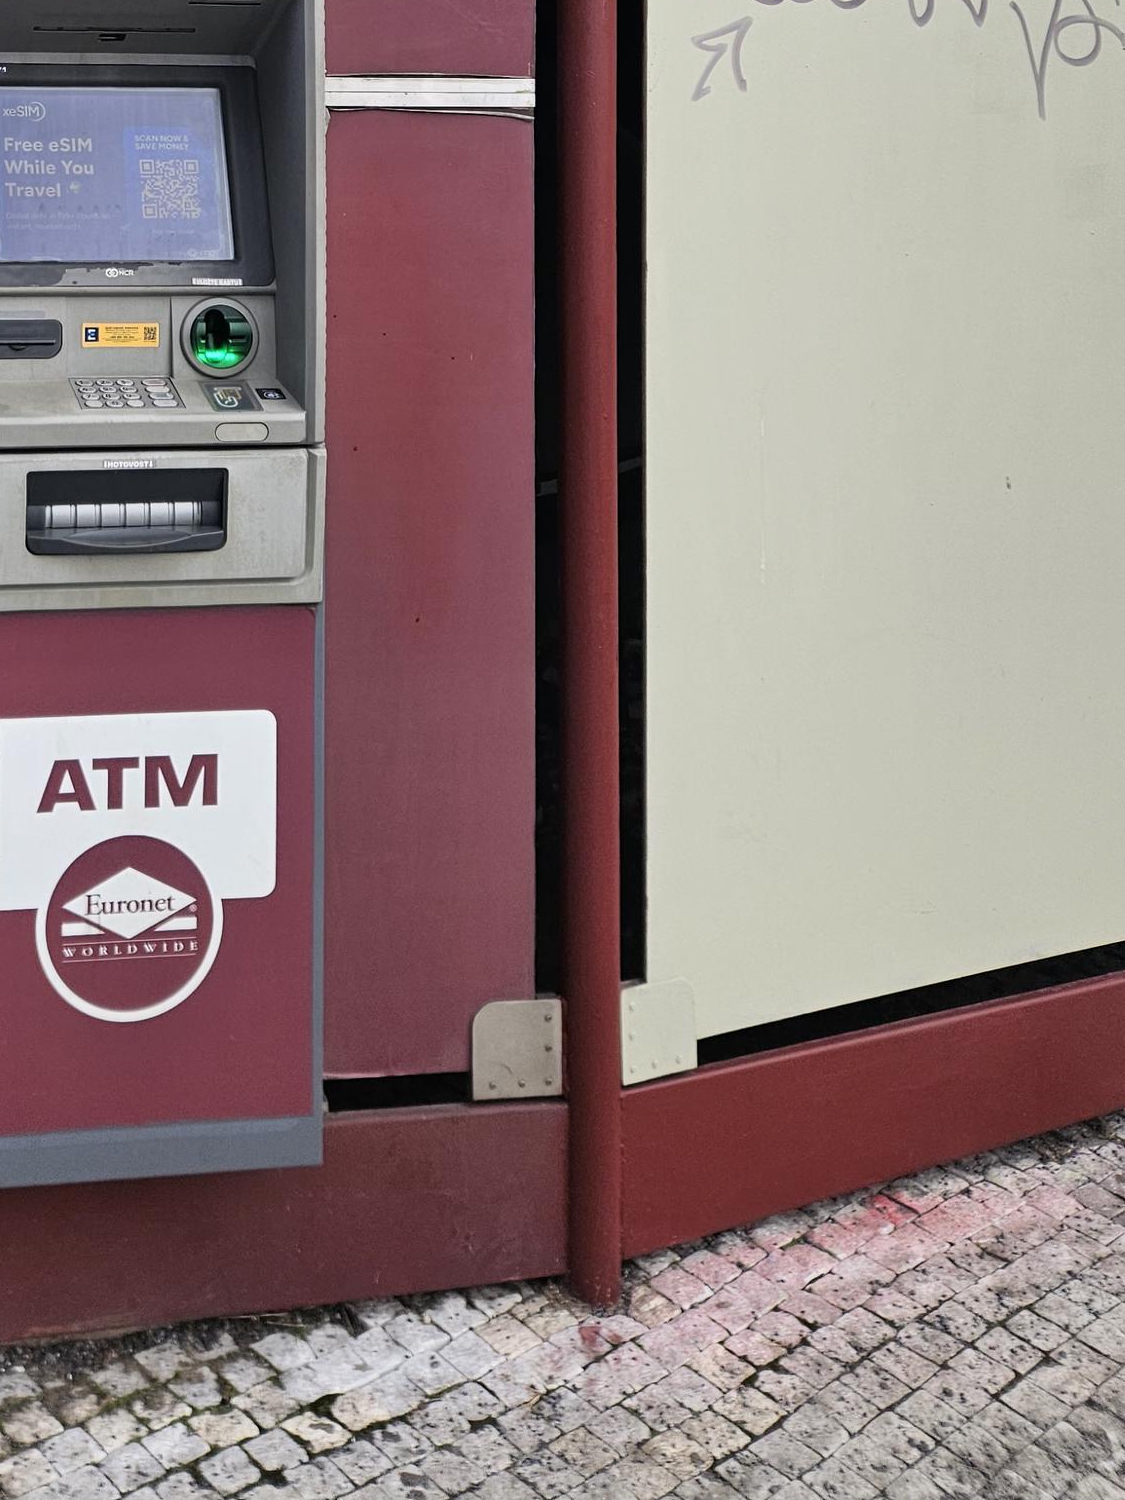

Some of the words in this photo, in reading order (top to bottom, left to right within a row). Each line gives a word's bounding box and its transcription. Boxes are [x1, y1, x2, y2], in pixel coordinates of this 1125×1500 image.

[2, 105, 40, 117] xeSIM
[4, 137, 44, 152] Free
[48, 137, 93, 153] eSIM
[134, 134, 158, 142] SCAN
[135, 142, 156, 150] SAVE
[4, 160, 56, 174] While
[61, 160, 95, 175] You
[5, 182, 62, 198] Travel
[36, 753, 219, 814] ATM
[84, 893, 176, 917] Euronet
[62, 939, 200, 958] WORLDWIDE
